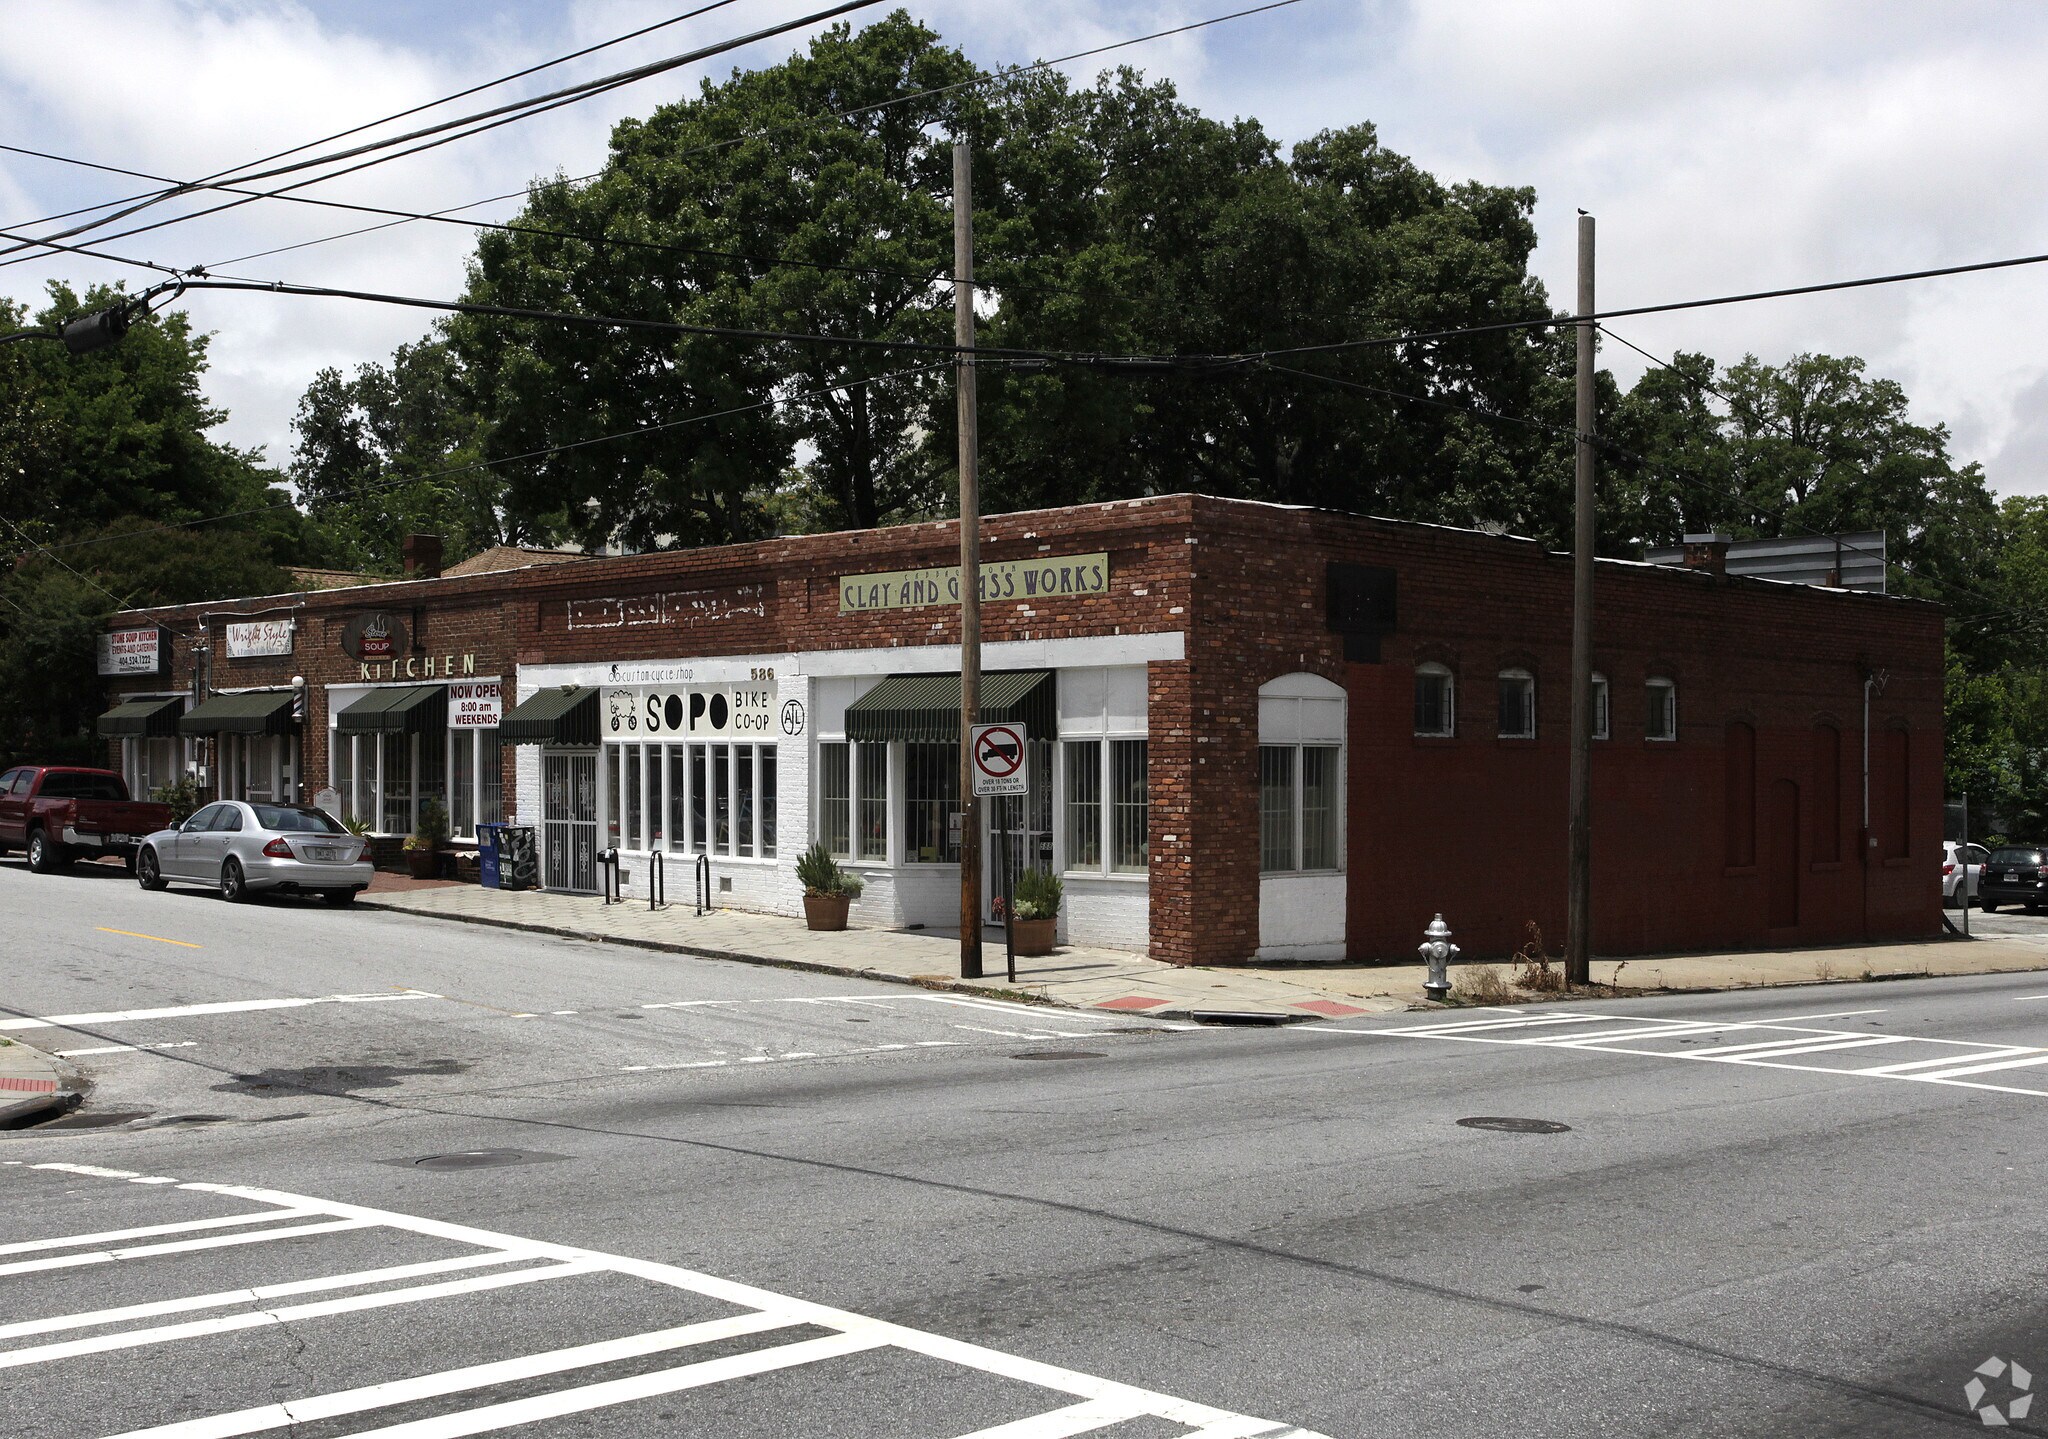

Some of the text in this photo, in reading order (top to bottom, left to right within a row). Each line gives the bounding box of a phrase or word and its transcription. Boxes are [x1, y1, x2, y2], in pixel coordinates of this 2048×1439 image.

[844, 565, 1103, 609] CLAY AND GASS WORKS
[111, 631, 157, 644] STONE SOUP KITCHEN
[232, 622, 287, 648] Wright Style
[112, 642, 157, 655] EVENTS AND CATERING
[365, 642, 390, 651] SOUP
[361, 654, 474, 680] KITCHEN
[675, 667, 693, 682] shop
[750, 667, 775, 681] 586
[450, 684, 503, 699] NOW OPEN
[460, 701, 492, 712] 8:00 am
[646, 691, 768, 732] SOPO BIKE
[455, 713, 498, 725] WEEKENDS
[735, 714, 770, 731] CO-OP
